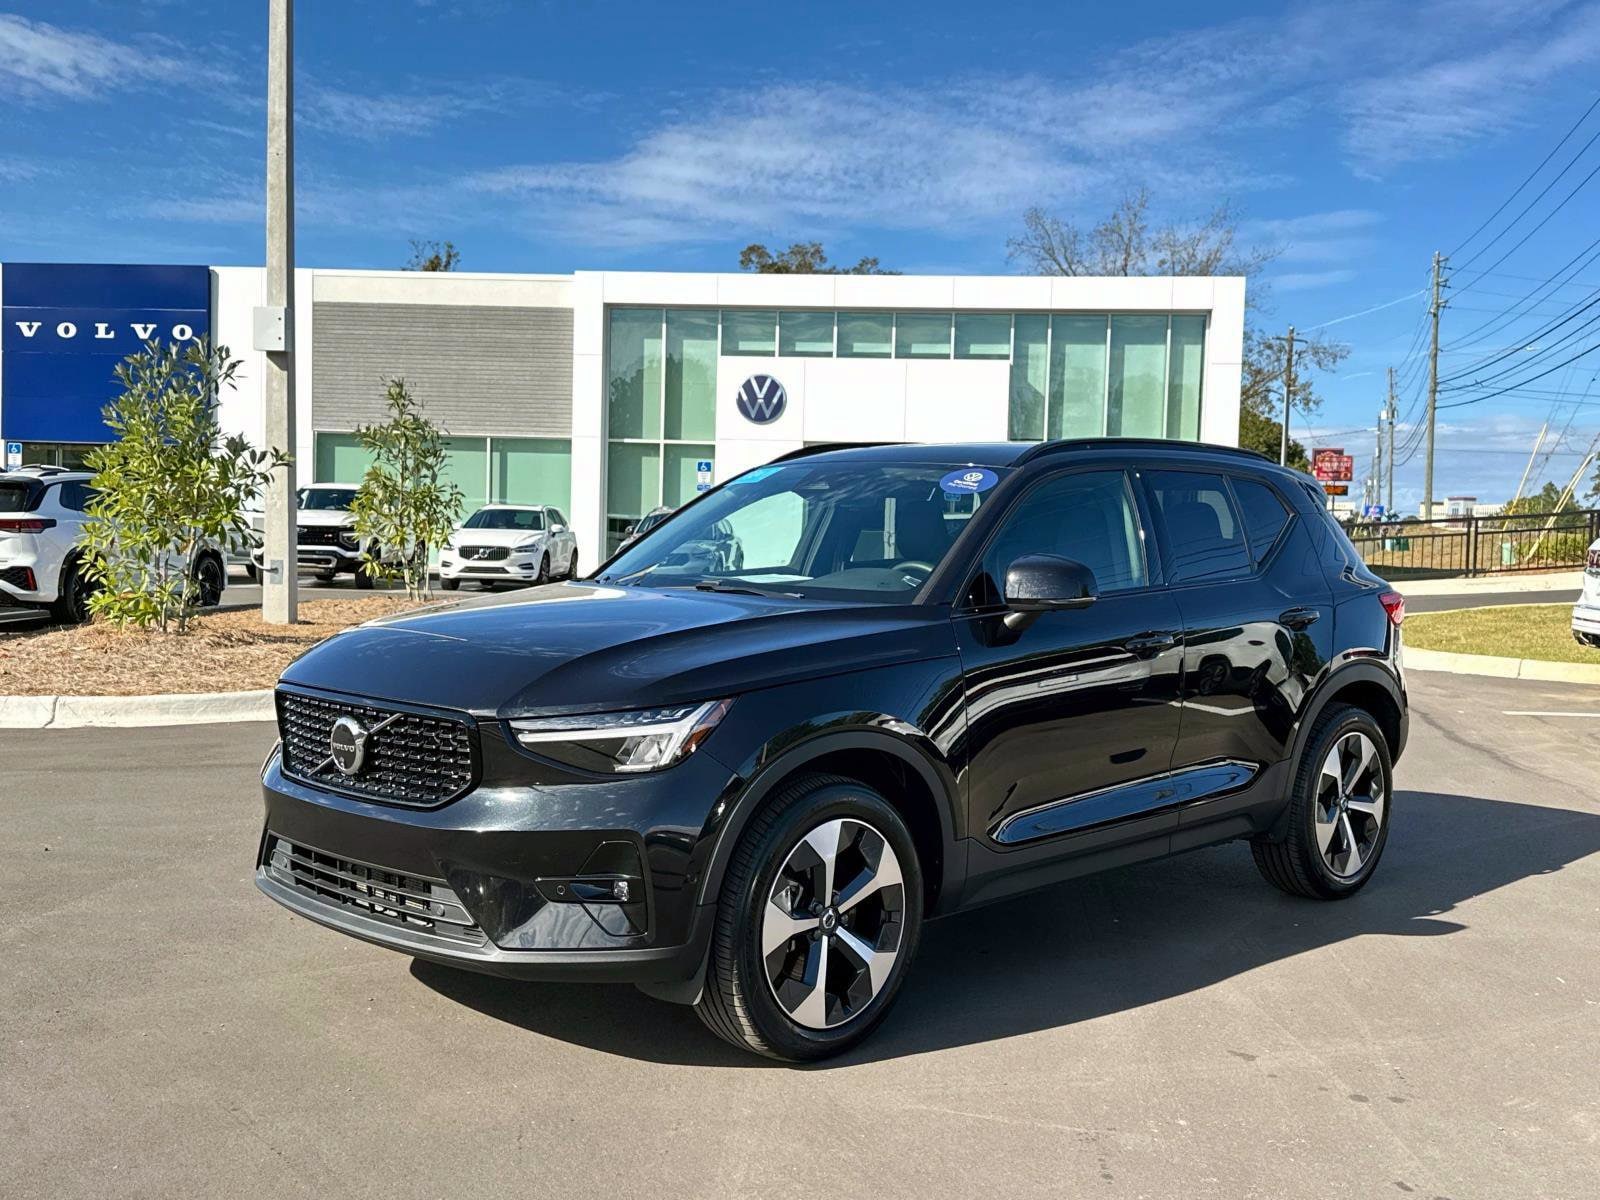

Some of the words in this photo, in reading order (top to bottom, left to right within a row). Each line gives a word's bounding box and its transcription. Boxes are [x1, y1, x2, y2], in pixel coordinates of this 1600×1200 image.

[16, 322, 193, 341] VOLVO
[738, 375, 785, 421] VW
[332, 742, 355, 753] VOLVO
